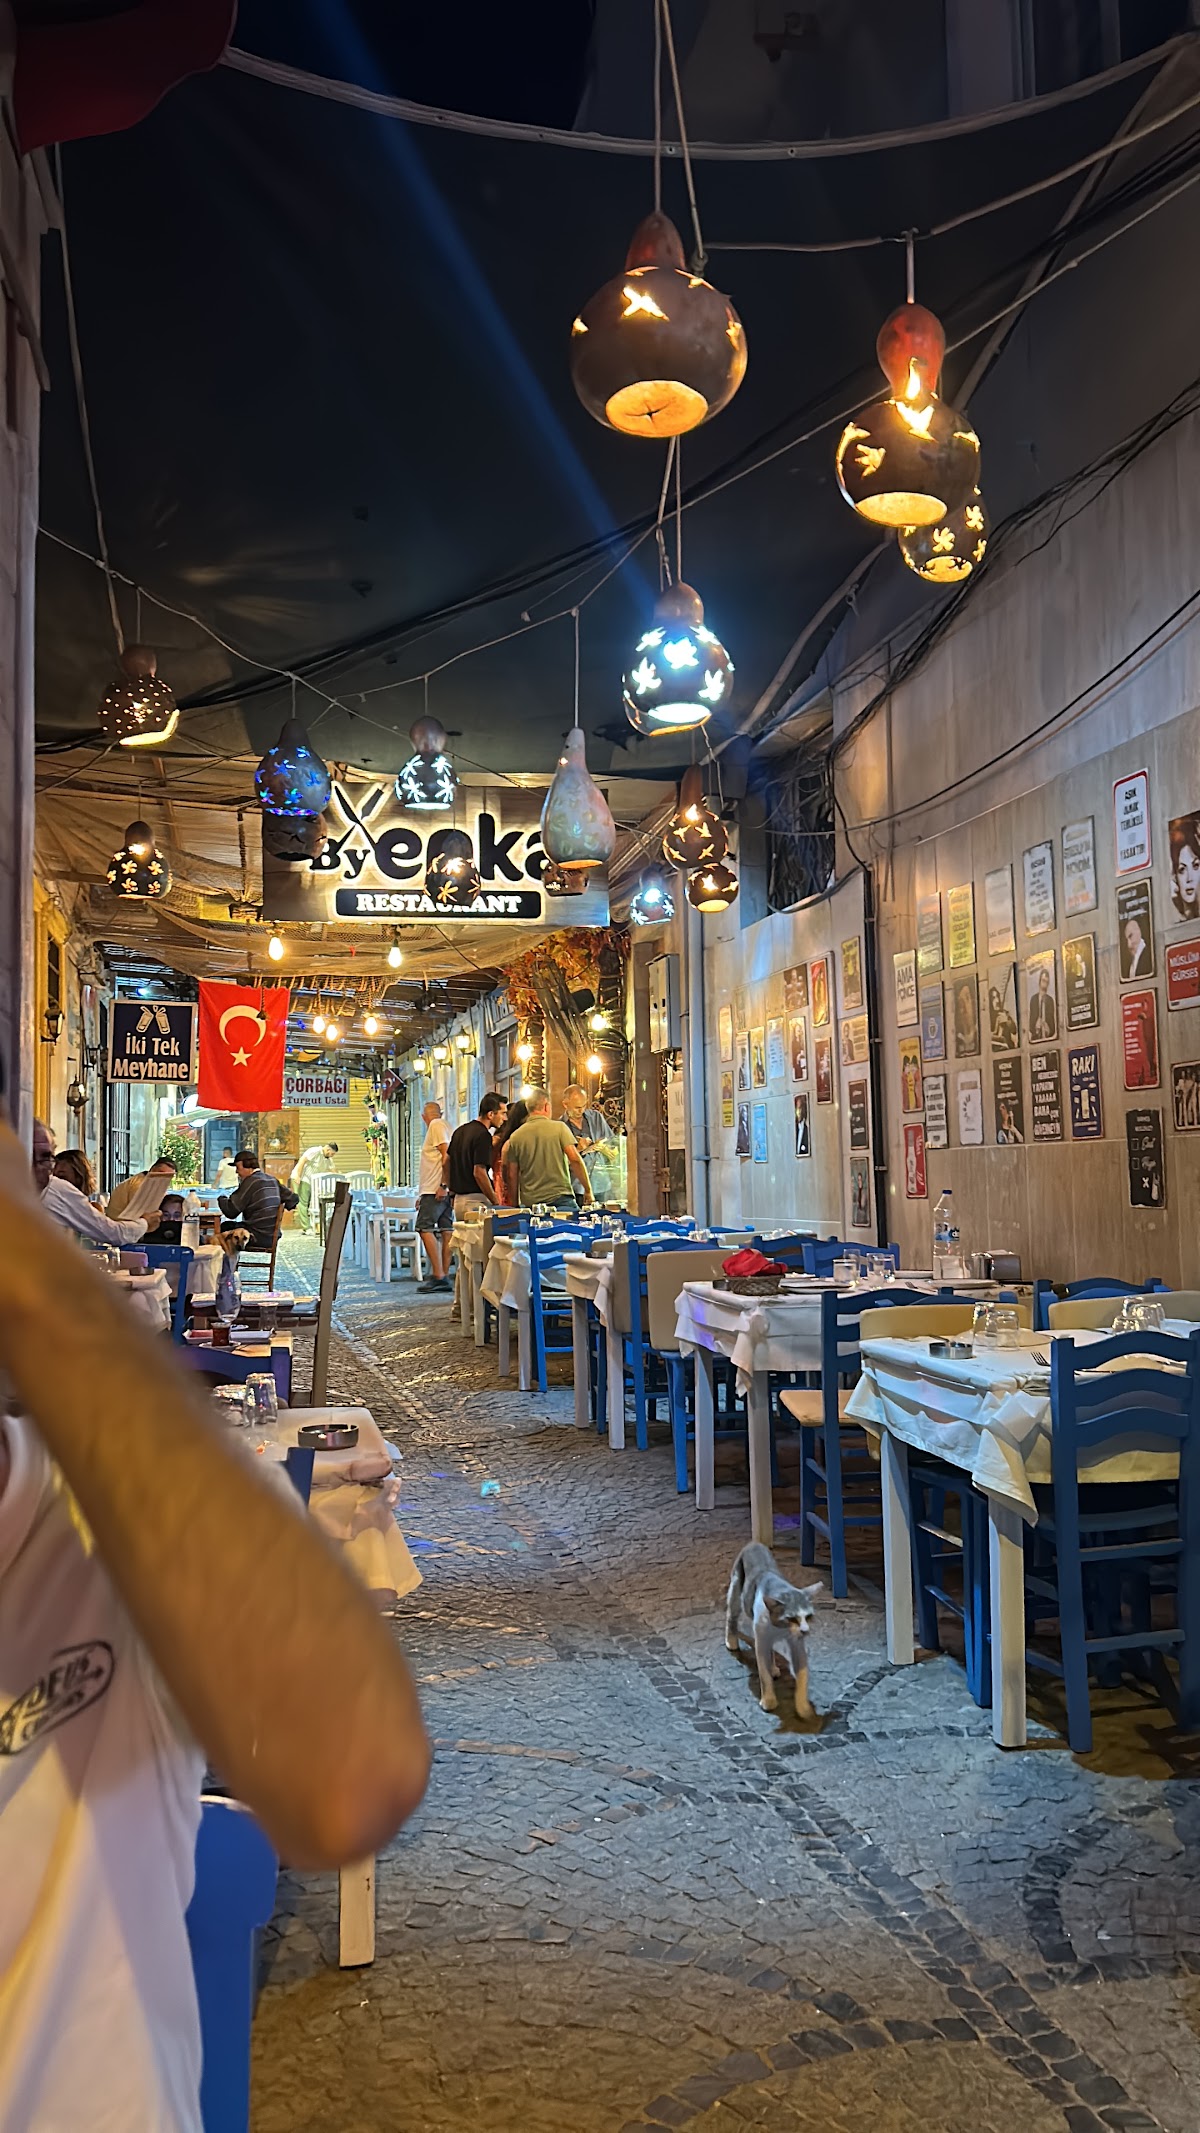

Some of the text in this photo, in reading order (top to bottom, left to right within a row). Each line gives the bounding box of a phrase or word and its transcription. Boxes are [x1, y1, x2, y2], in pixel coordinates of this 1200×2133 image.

[356, 893, 522, 913] RESTAUANT
[1169, 951, 1200, 968] MÜSLÜM
[1171, 967, 1199, 982] GÜRSES
[151, 1037, 180, 1056] Tek
[113, 1057, 189, 1080] Meyhane
[1032, 1056, 1047, 1071] BEN
[1071, 1054, 1095, 1076] RAKI
[285, 1077, 347, 1094] ÇORBACI
[287, 1096, 347, 1106] Turgut Usta
